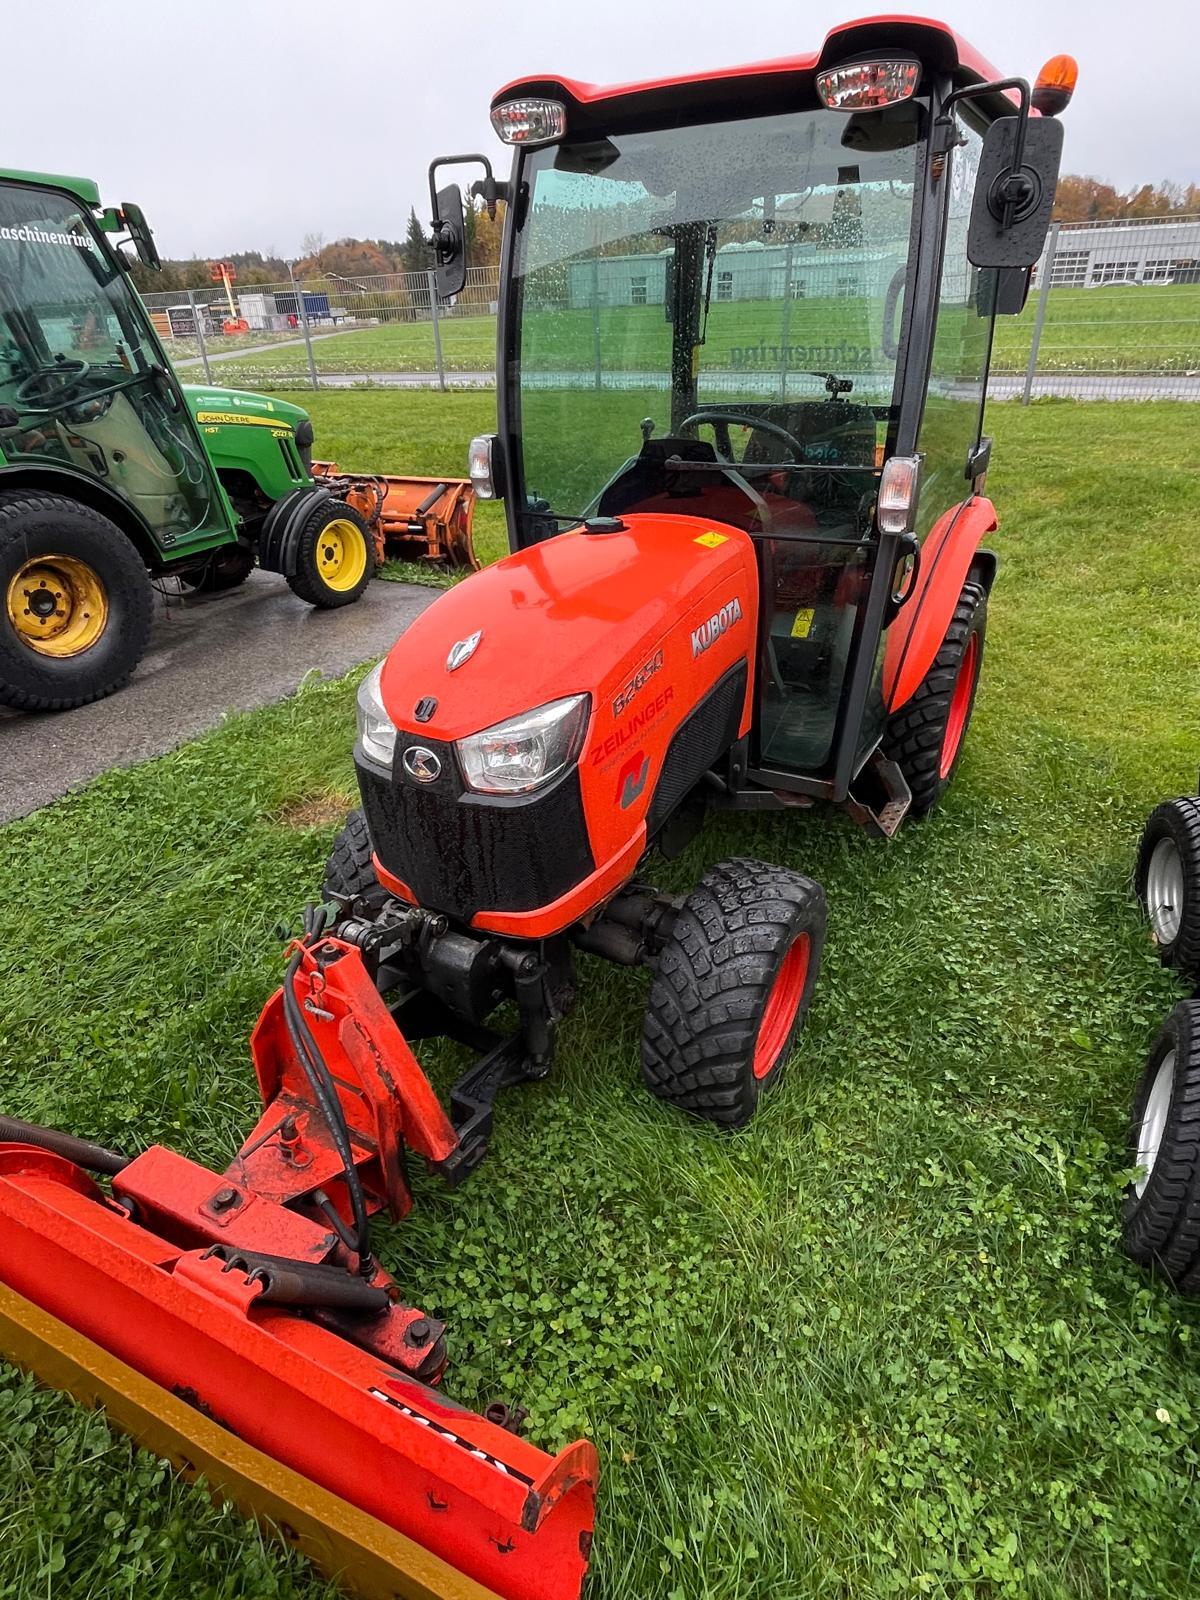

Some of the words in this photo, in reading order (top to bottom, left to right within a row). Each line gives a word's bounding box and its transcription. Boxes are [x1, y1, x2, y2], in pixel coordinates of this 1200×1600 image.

[0, 226, 94, 251] aschinenring
[201, 413, 225, 423] JOHN
[225, 414, 250, 424] DEERE
[690, 596, 742, 658] KUBOTA
[612, 650, 664, 720] B2650
[590, 685, 675, 766] ZEILINGER
